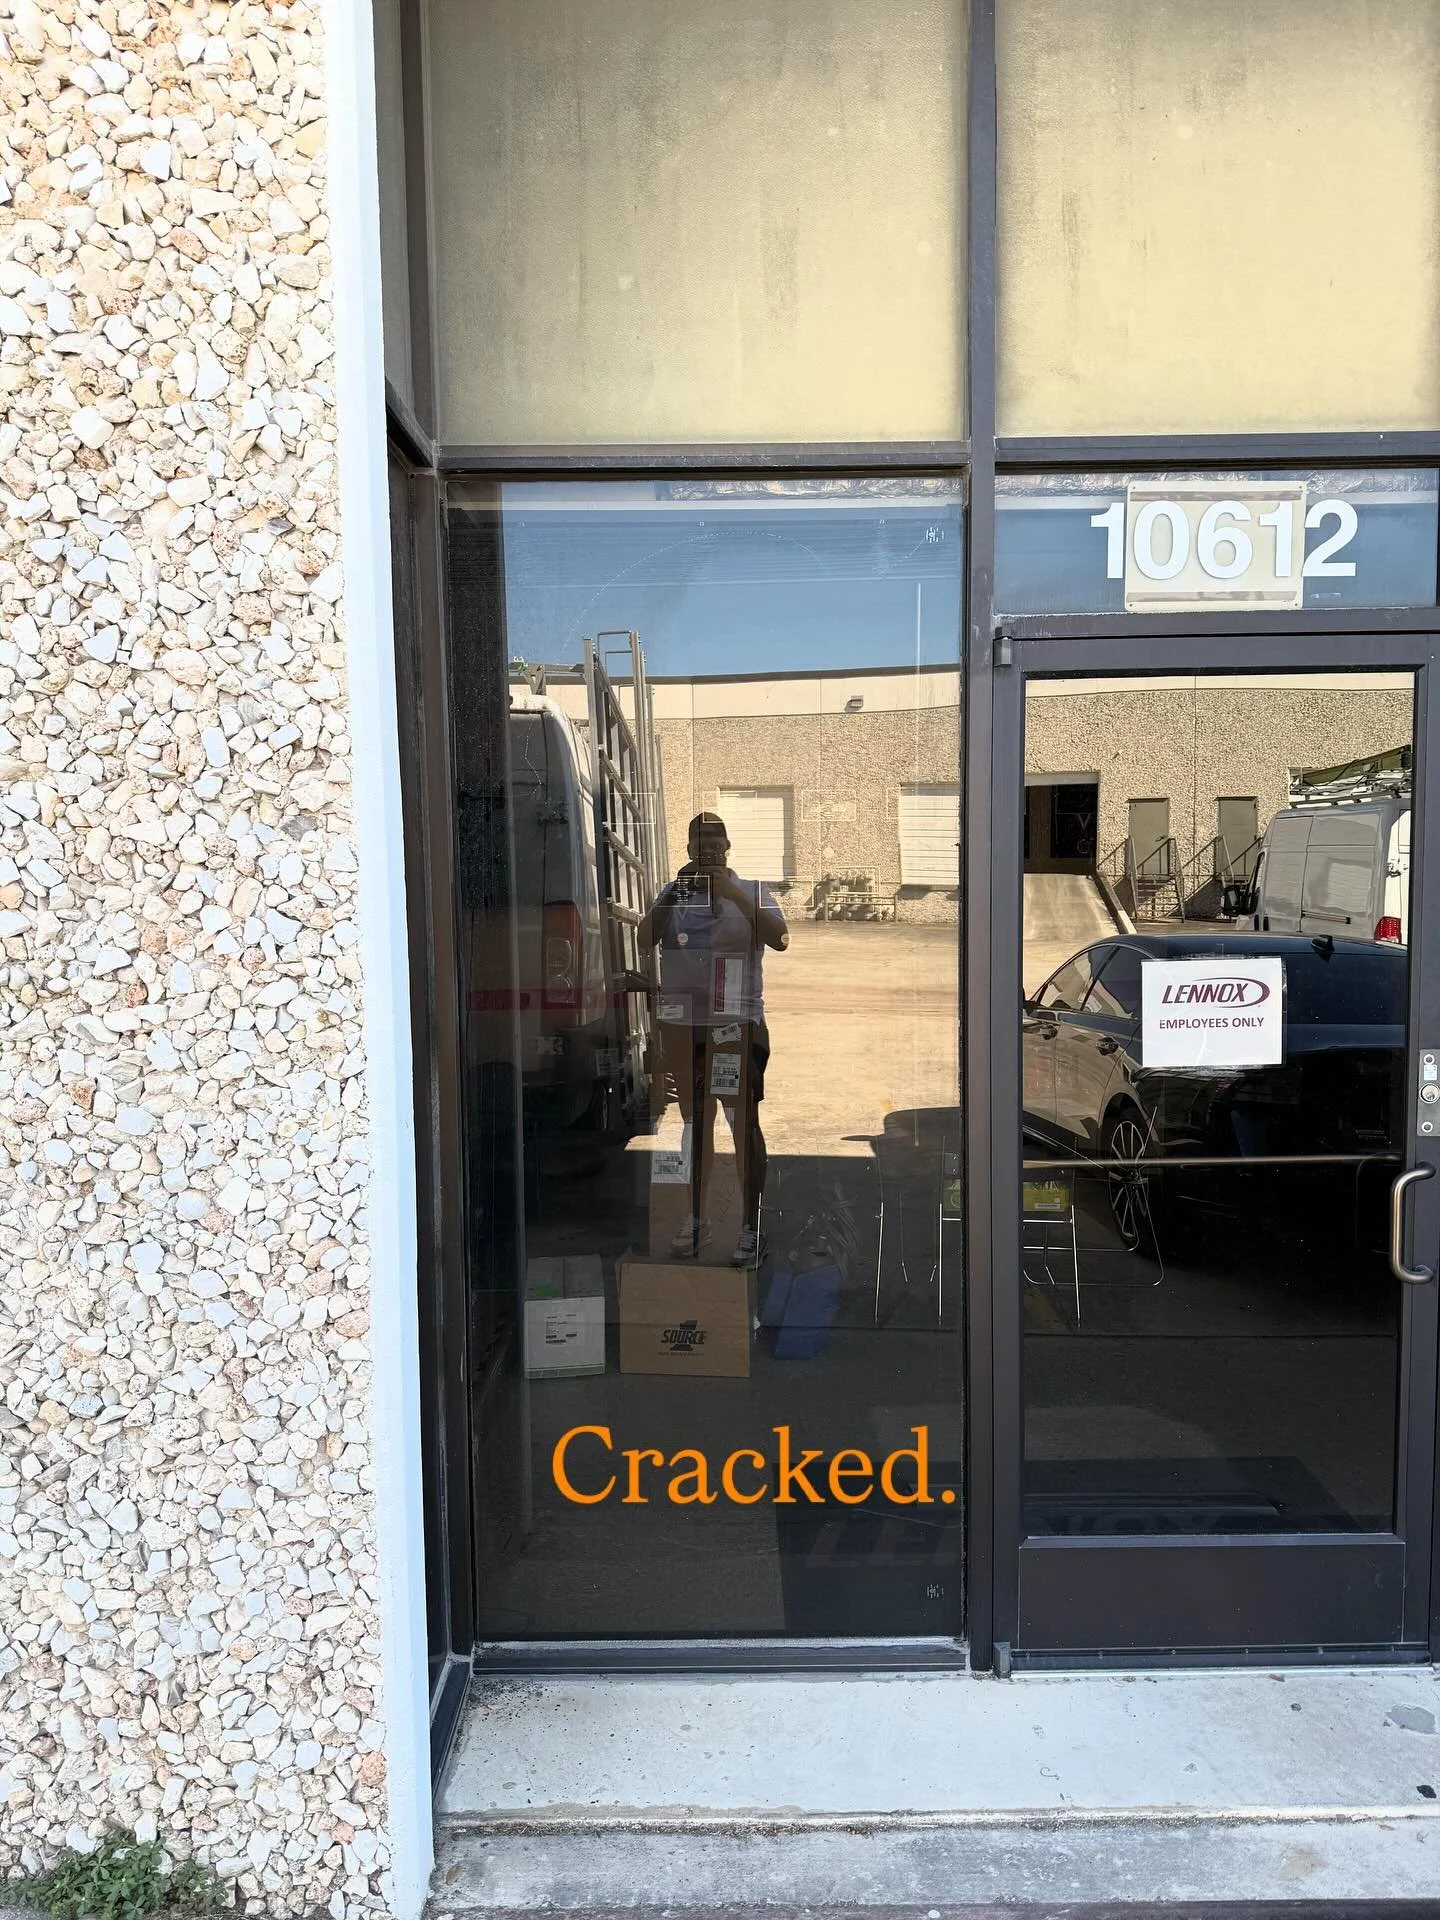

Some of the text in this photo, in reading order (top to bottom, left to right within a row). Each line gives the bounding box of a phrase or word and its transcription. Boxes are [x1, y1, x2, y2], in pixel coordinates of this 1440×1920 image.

[1090, 499, 1358, 580] 10612
[1161, 982, 1249, 1004] LENNOX
[1159, 1017, 1265, 1029] EMPLOYEES ONLY
[660, 1329, 707, 1344] SOURCE
